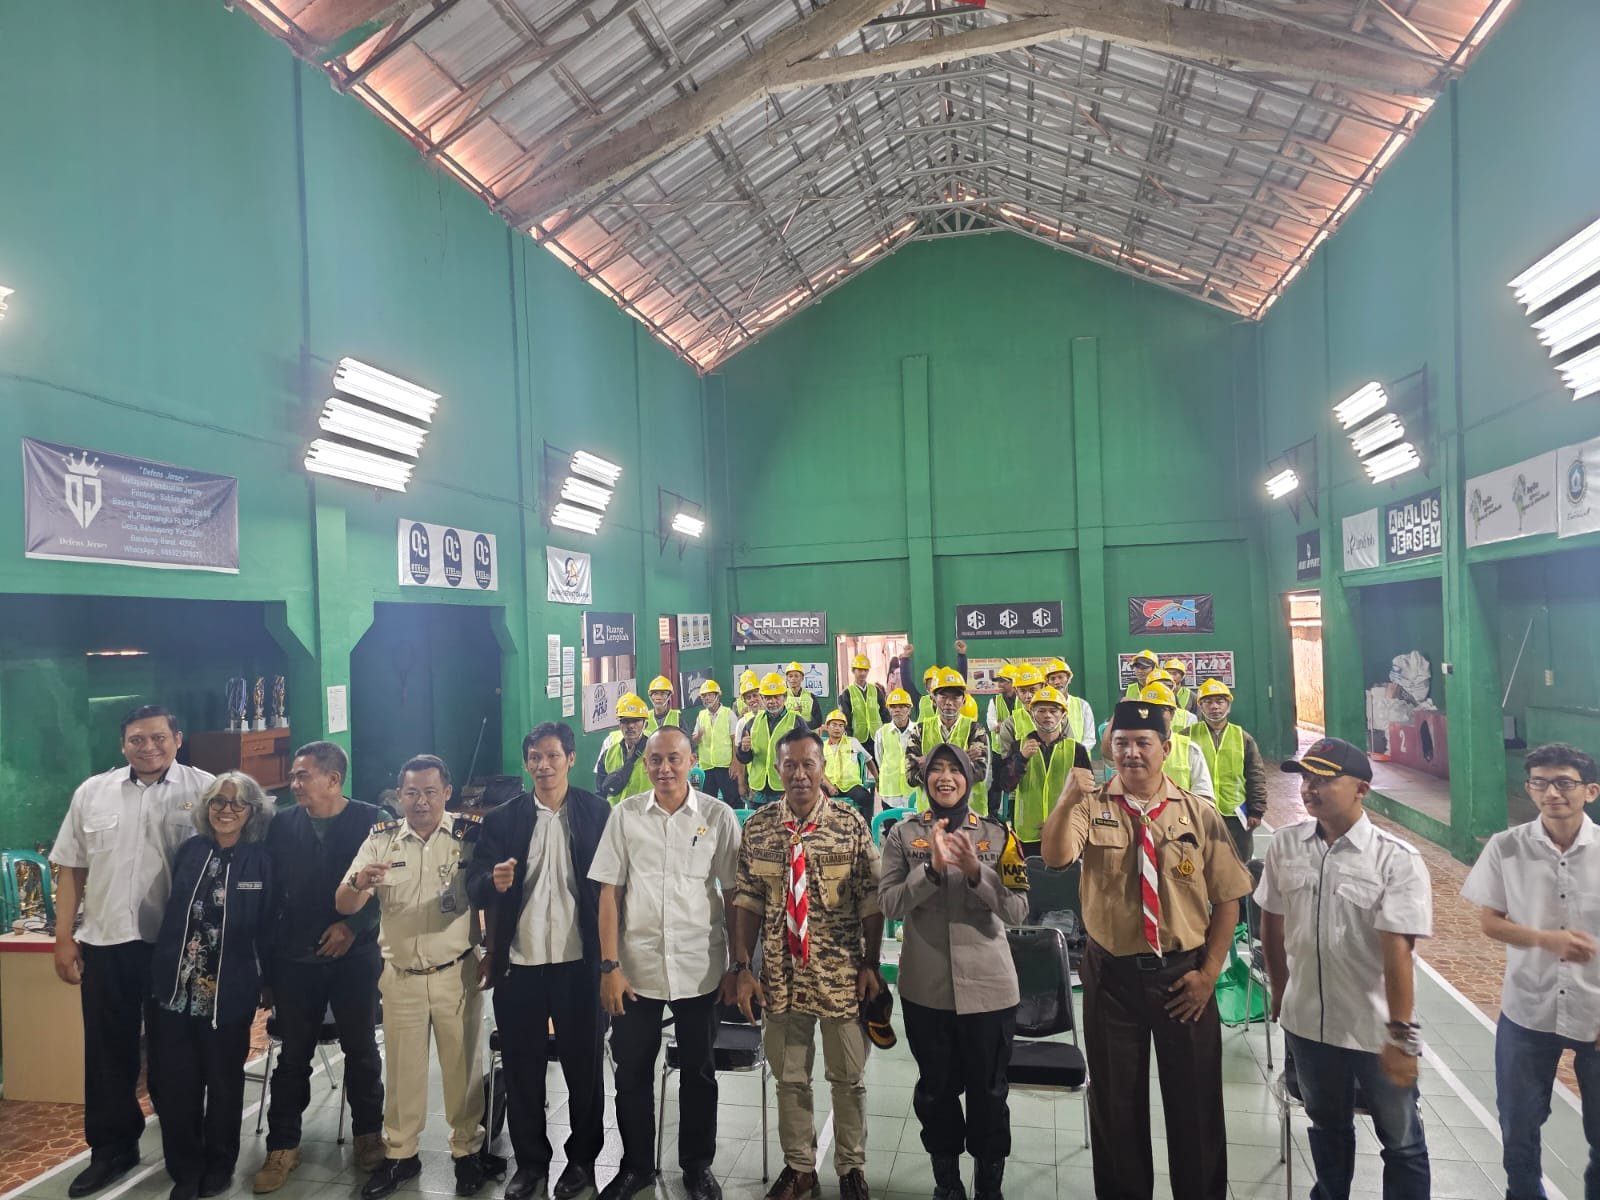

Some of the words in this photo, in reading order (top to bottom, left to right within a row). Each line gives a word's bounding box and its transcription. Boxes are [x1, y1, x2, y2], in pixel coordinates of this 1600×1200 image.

[1388, 498, 1440, 534] ARALUS
[1390, 520, 1441, 555] JERSEY
[753, 617, 820, 628] CALDERA
[1400, 730, 1407, 753] 2
